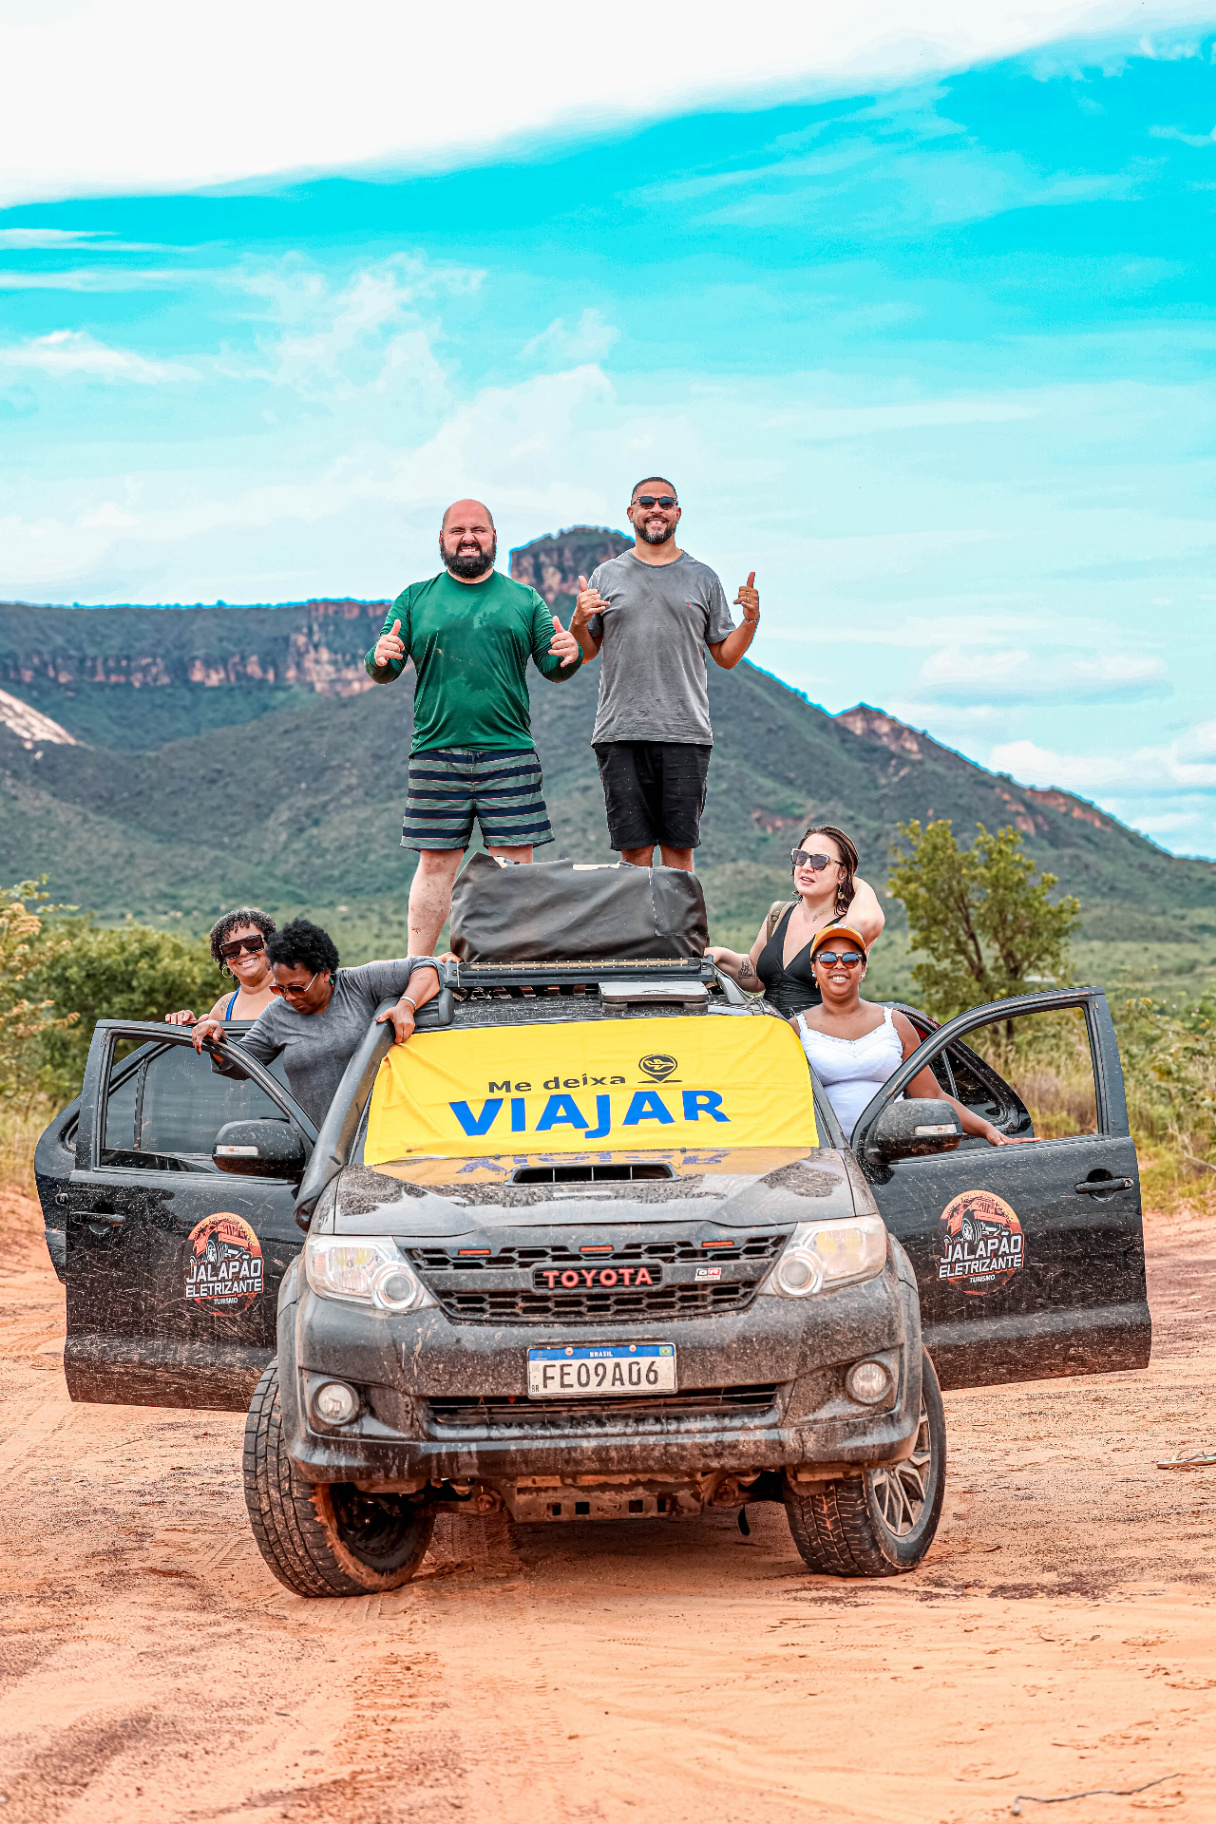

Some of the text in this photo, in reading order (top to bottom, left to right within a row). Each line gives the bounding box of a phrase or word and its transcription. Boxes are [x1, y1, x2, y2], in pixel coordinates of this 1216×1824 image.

[488, 1073, 626, 1093] Me deixa
[448, 1090, 732, 1139] VIAJAR
[940, 1231, 1022, 1263] JALAPÃO
[185, 1254, 262, 1283] JALAPÃO
[939, 1254, 1022, 1278] ELETRIZANTE
[185, 1278, 262, 1298] ELETRIZANTE
[543, 1267, 653, 1289] TOYOTA
[969, 1274, 996, 1283] TURISMO
[213, 1297, 239, 1305] TURISMO
[531, 1384, 540, 1393] BR
